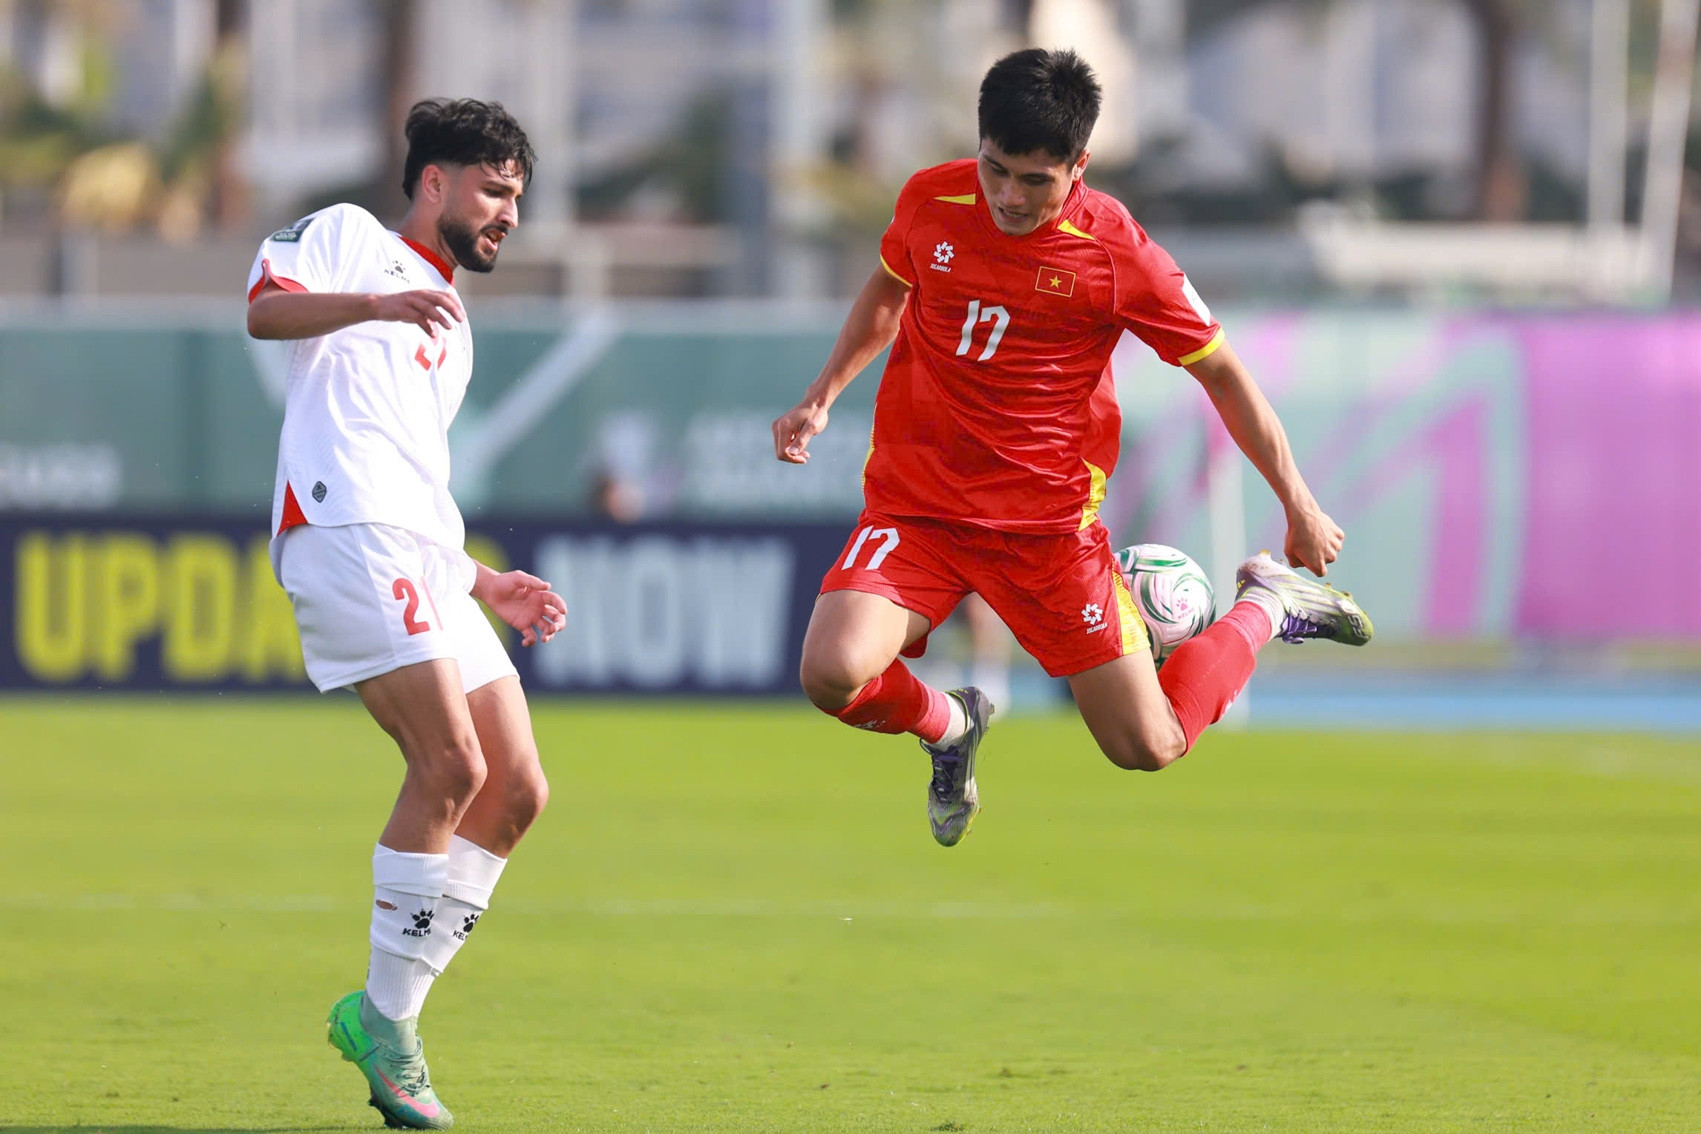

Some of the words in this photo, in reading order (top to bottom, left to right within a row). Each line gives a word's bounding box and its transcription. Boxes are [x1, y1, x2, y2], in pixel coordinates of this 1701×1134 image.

[955, 299, 1011, 362] 17
[841, 525, 900, 571] 17
[534, 532, 795, 687] NOW
[402, 928, 431, 937] KELM
